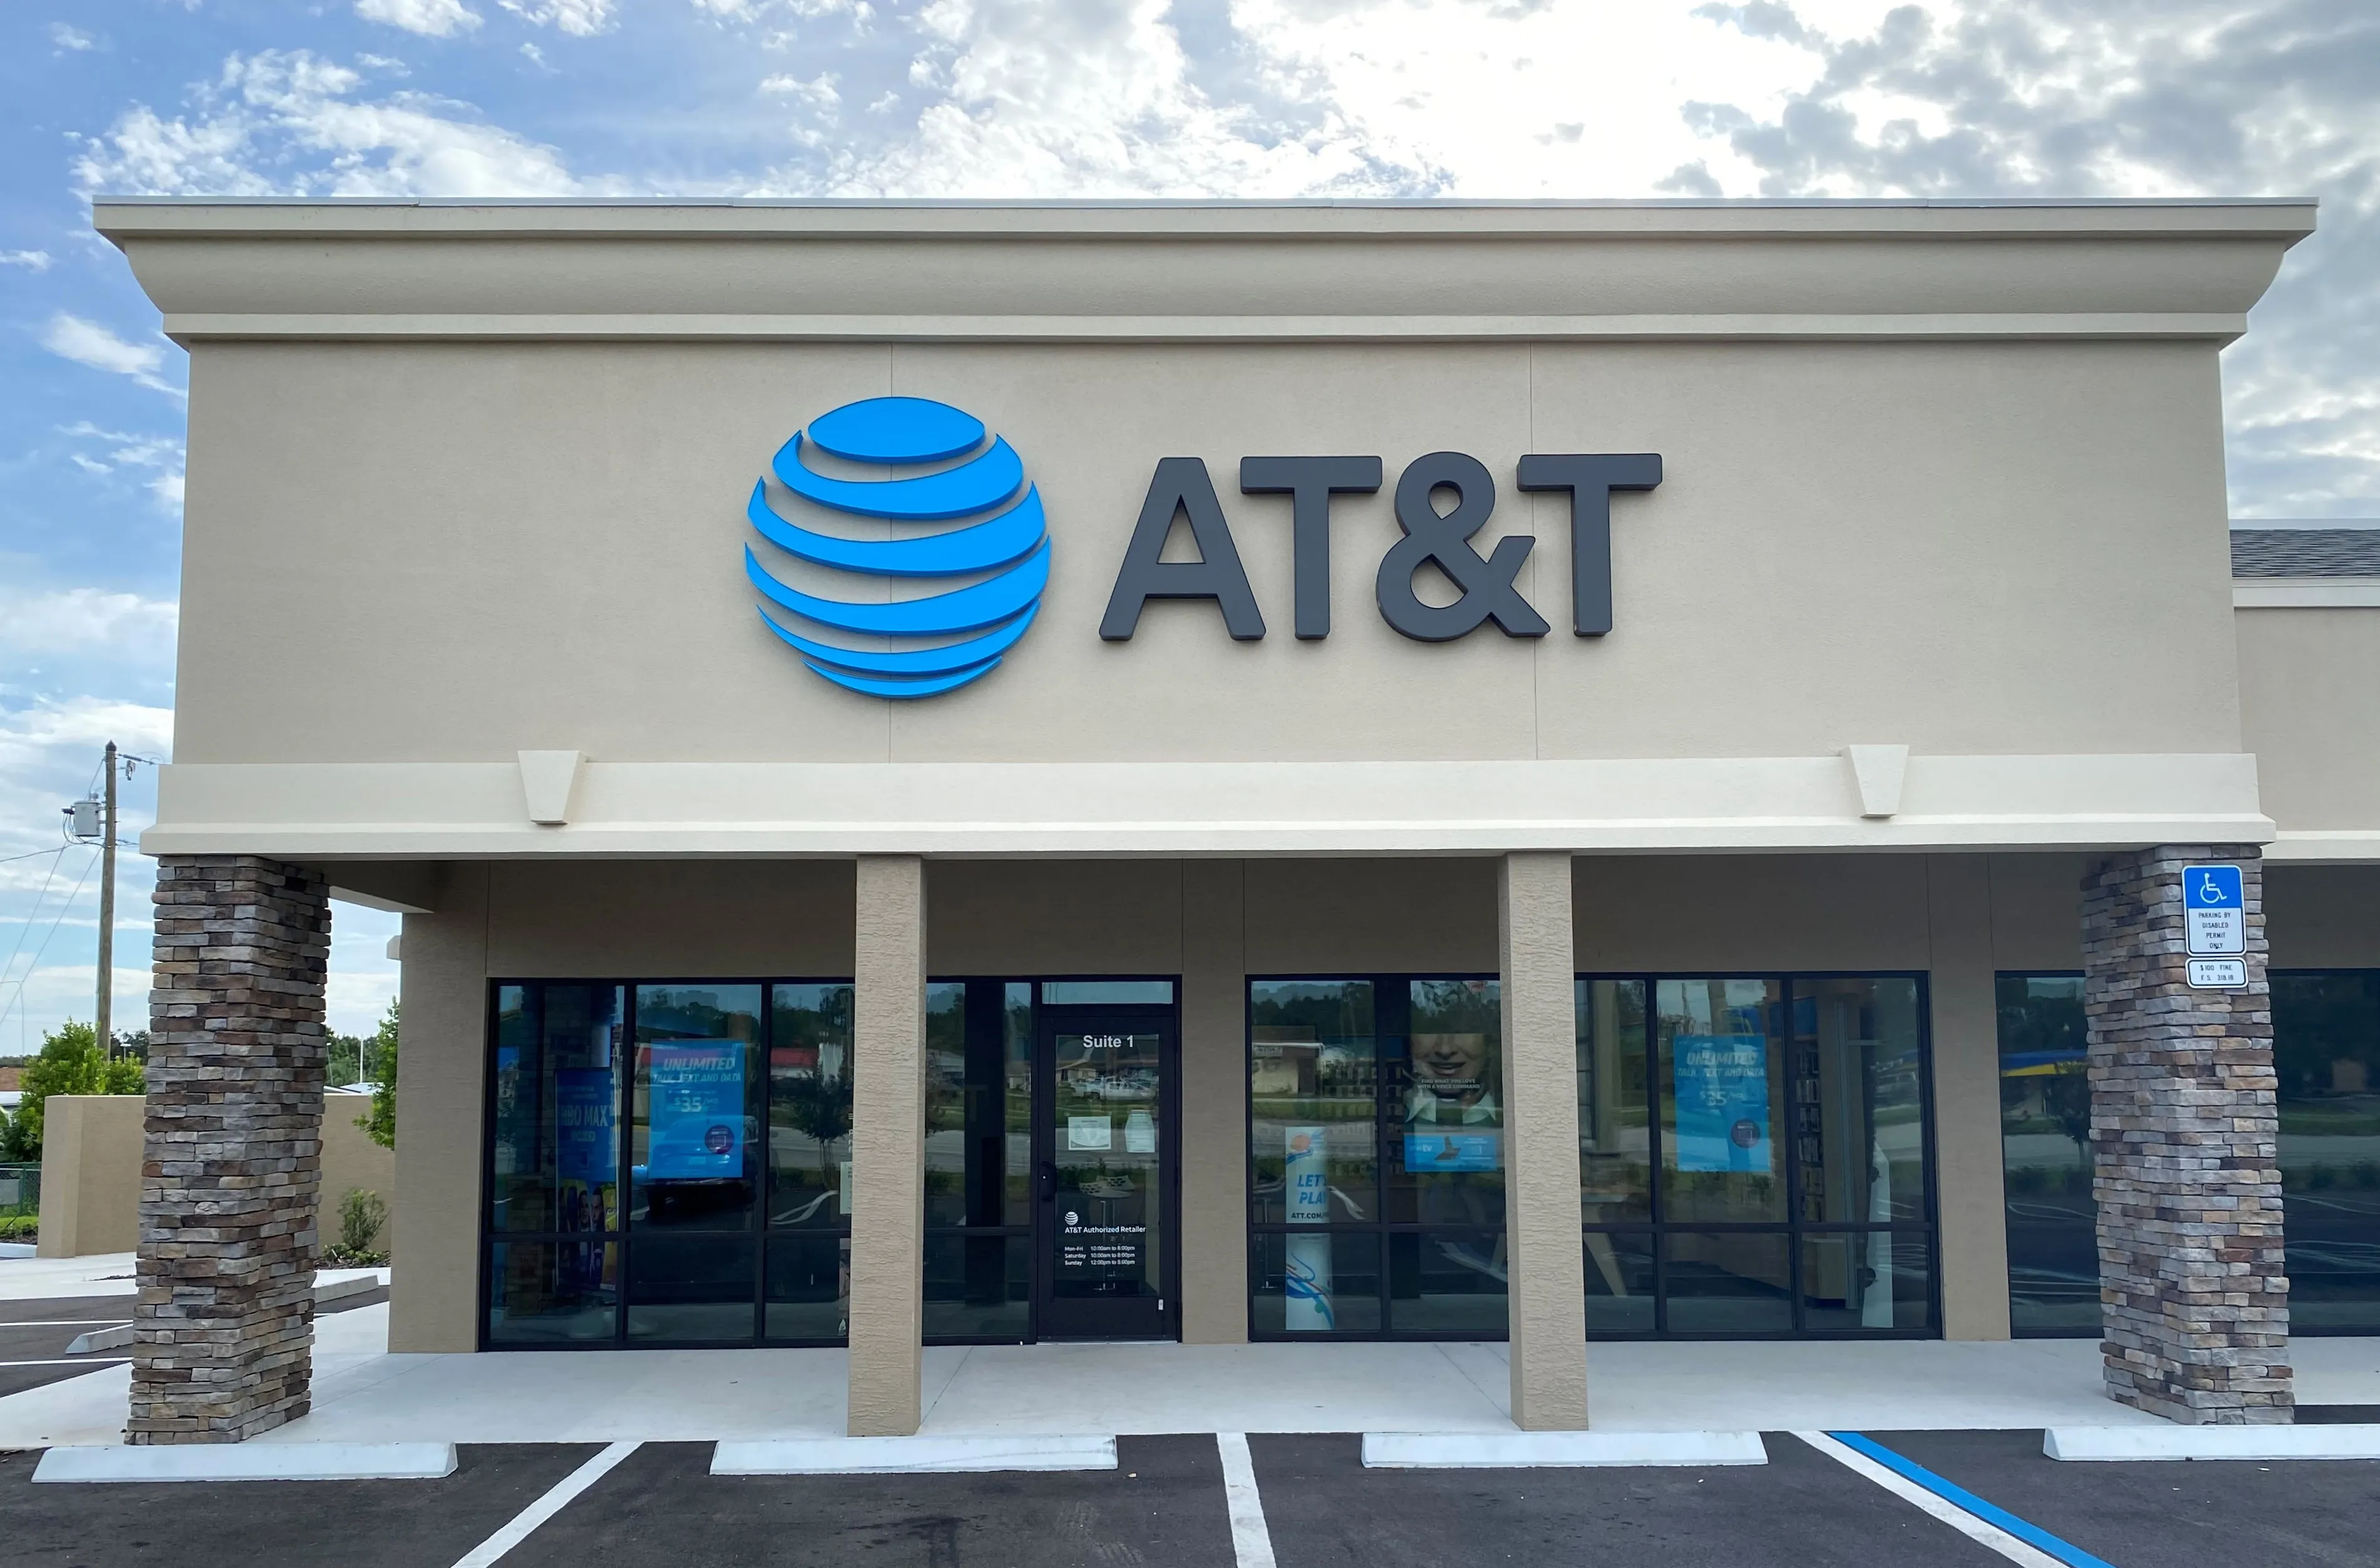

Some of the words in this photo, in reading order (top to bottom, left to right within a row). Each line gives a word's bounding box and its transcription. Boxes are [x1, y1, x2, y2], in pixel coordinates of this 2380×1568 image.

[1098, 450, 1664, 642] AT&T
[1083, 1034, 1122, 1048] Suite
[1126, 1035, 1134, 1048] 1
[663, 1057, 735, 1071] UNLIMITED
[701, 1073, 718, 1082] AND
[720, 1073, 741, 1082] DATA
[584, 1105, 609, 1127] MAX
